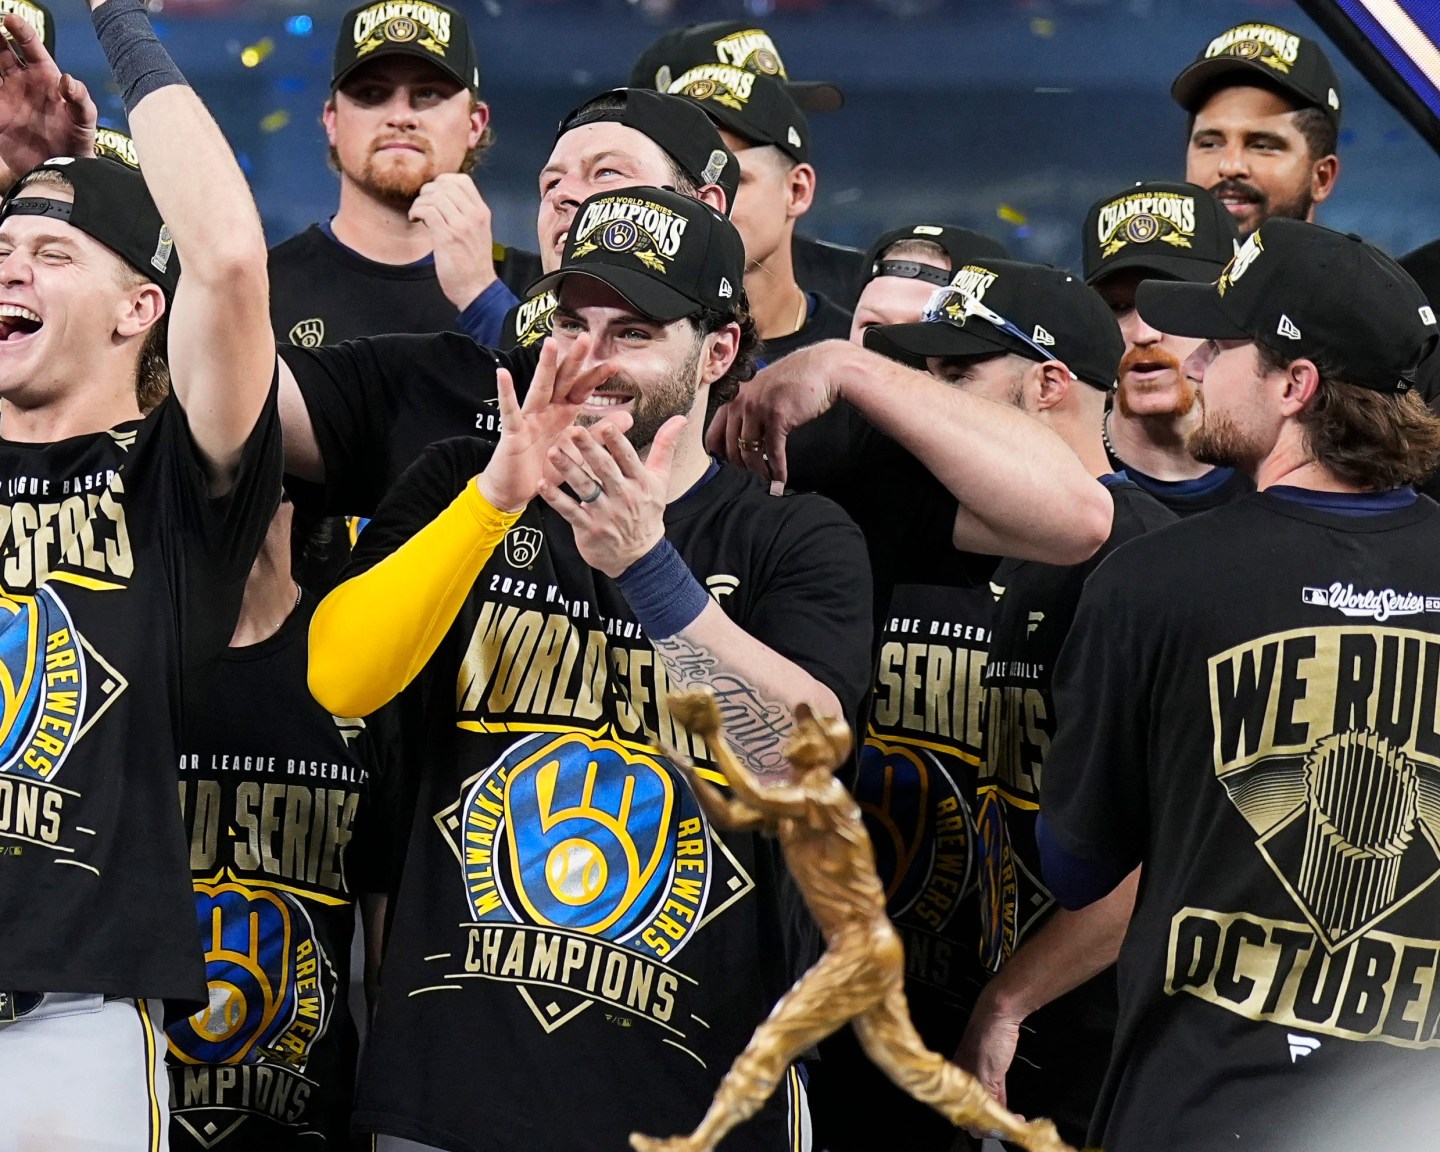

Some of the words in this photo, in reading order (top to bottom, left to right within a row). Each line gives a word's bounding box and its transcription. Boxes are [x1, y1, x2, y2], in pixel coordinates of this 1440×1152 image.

[353, 3, 451, 43] CHAMPIONS
[616, 196, 644, 206] WORLD
[1098, 197, 1195, 243] CHAMPIONS
[575, 202, 687, 256] CHAMPIONS
[9, 476, 50, 497] LGUE
[489, 574, 538, 600] 2026
[1329, 581, 1383, 609] World
[1373, 588, 1424, 622] Series
[457, 601, 608, 722] WORLD
[23, 627, 79, 778] BREWERS
[1216, 634, 1316, 766] WE
[211, 754, 276, 773] LEAGUE
[641, 816, 706, 957] BREWERS
[464, 928, 679, 1022] CHAMPIONS
